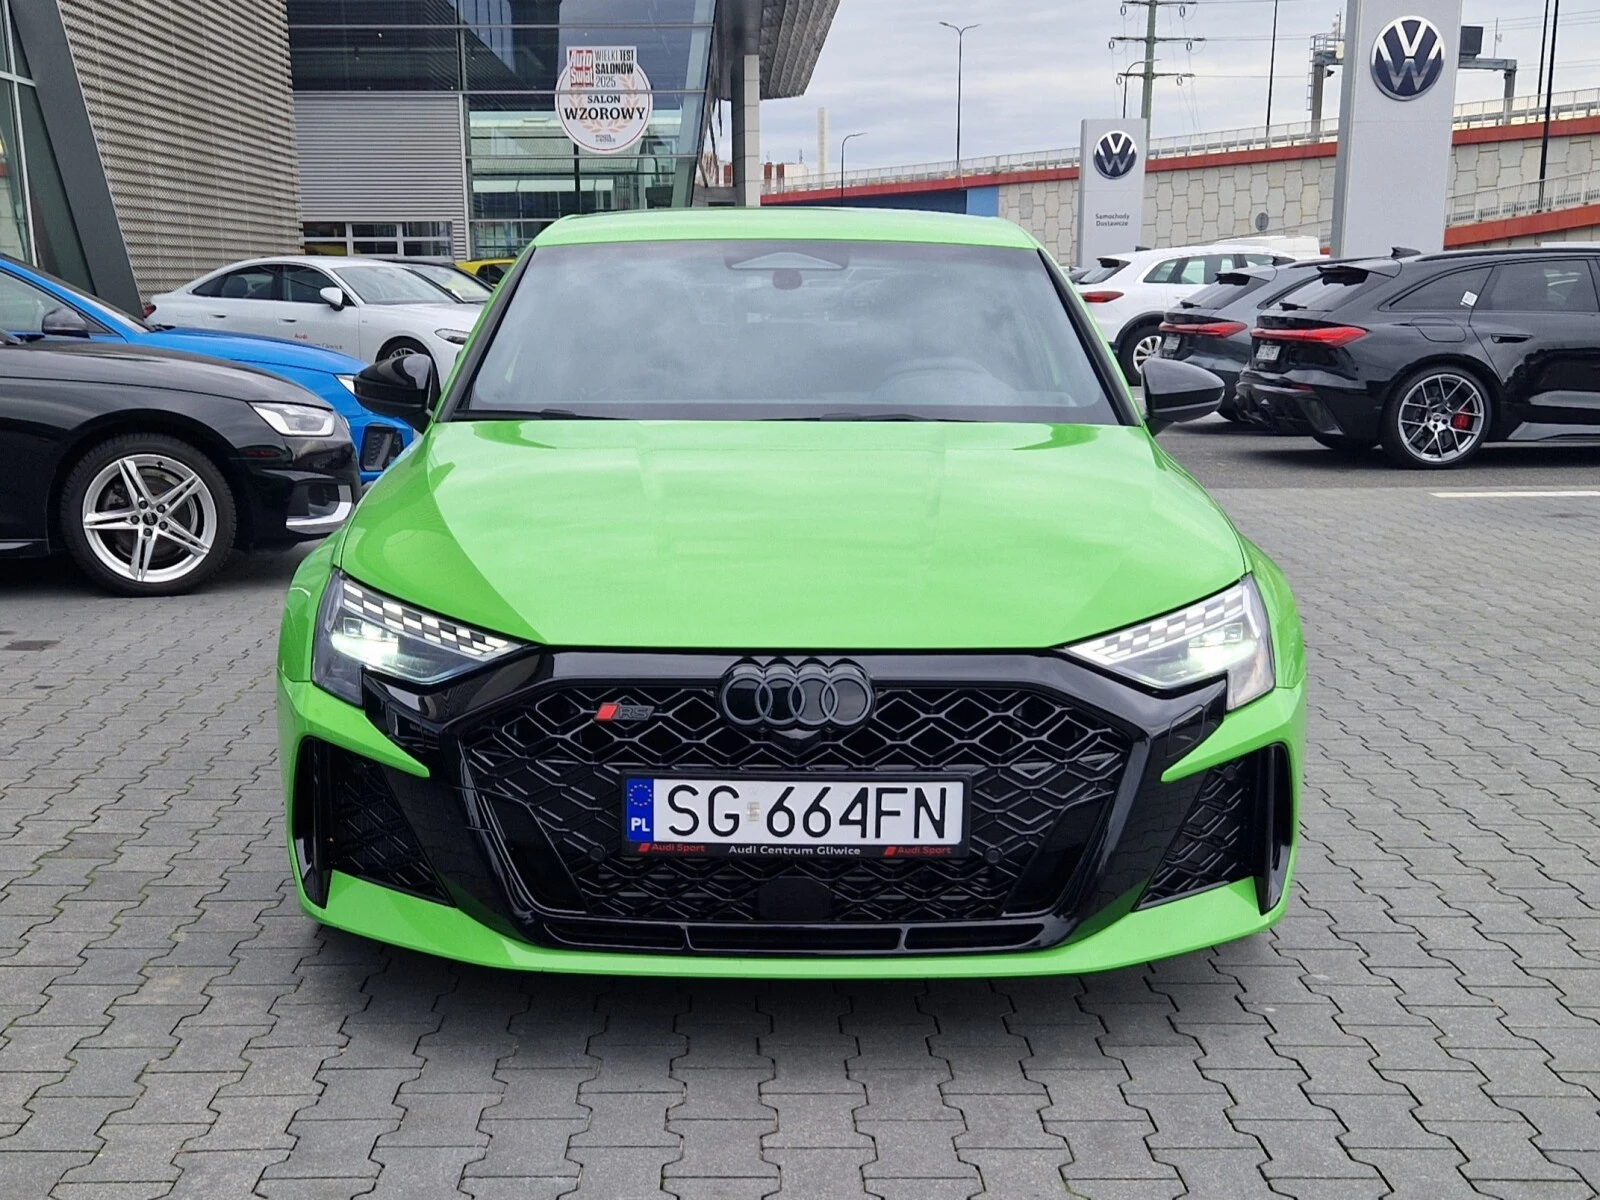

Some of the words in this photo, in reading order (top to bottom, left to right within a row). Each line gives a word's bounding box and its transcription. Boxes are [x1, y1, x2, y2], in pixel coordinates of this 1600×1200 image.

[570, 50, 593, 67] Auto
[594, 50, 618, 61] WIELKI
[619, 49, 634, 61] TEST
[595, 61, 634, 75] SALONÓW
[595, 75, 616, 88] 2025
[587, 95, 621, 104] SALON
[564, 107, 646, 120] WZOROWY
[619, 706, 649, 719] RS
[667, 784, 740, 837] SG
[766, 786, 947, 839] 664FN
[630, 817, 650, 832] PL
[677, 844, 705, 852] Sport
[728, 845, 756, 854] Audi
[760, 845, 813, 854] Centrum
[816, 846, 861, 855] Gliwice
[923, 847, 952, 855] Sport
